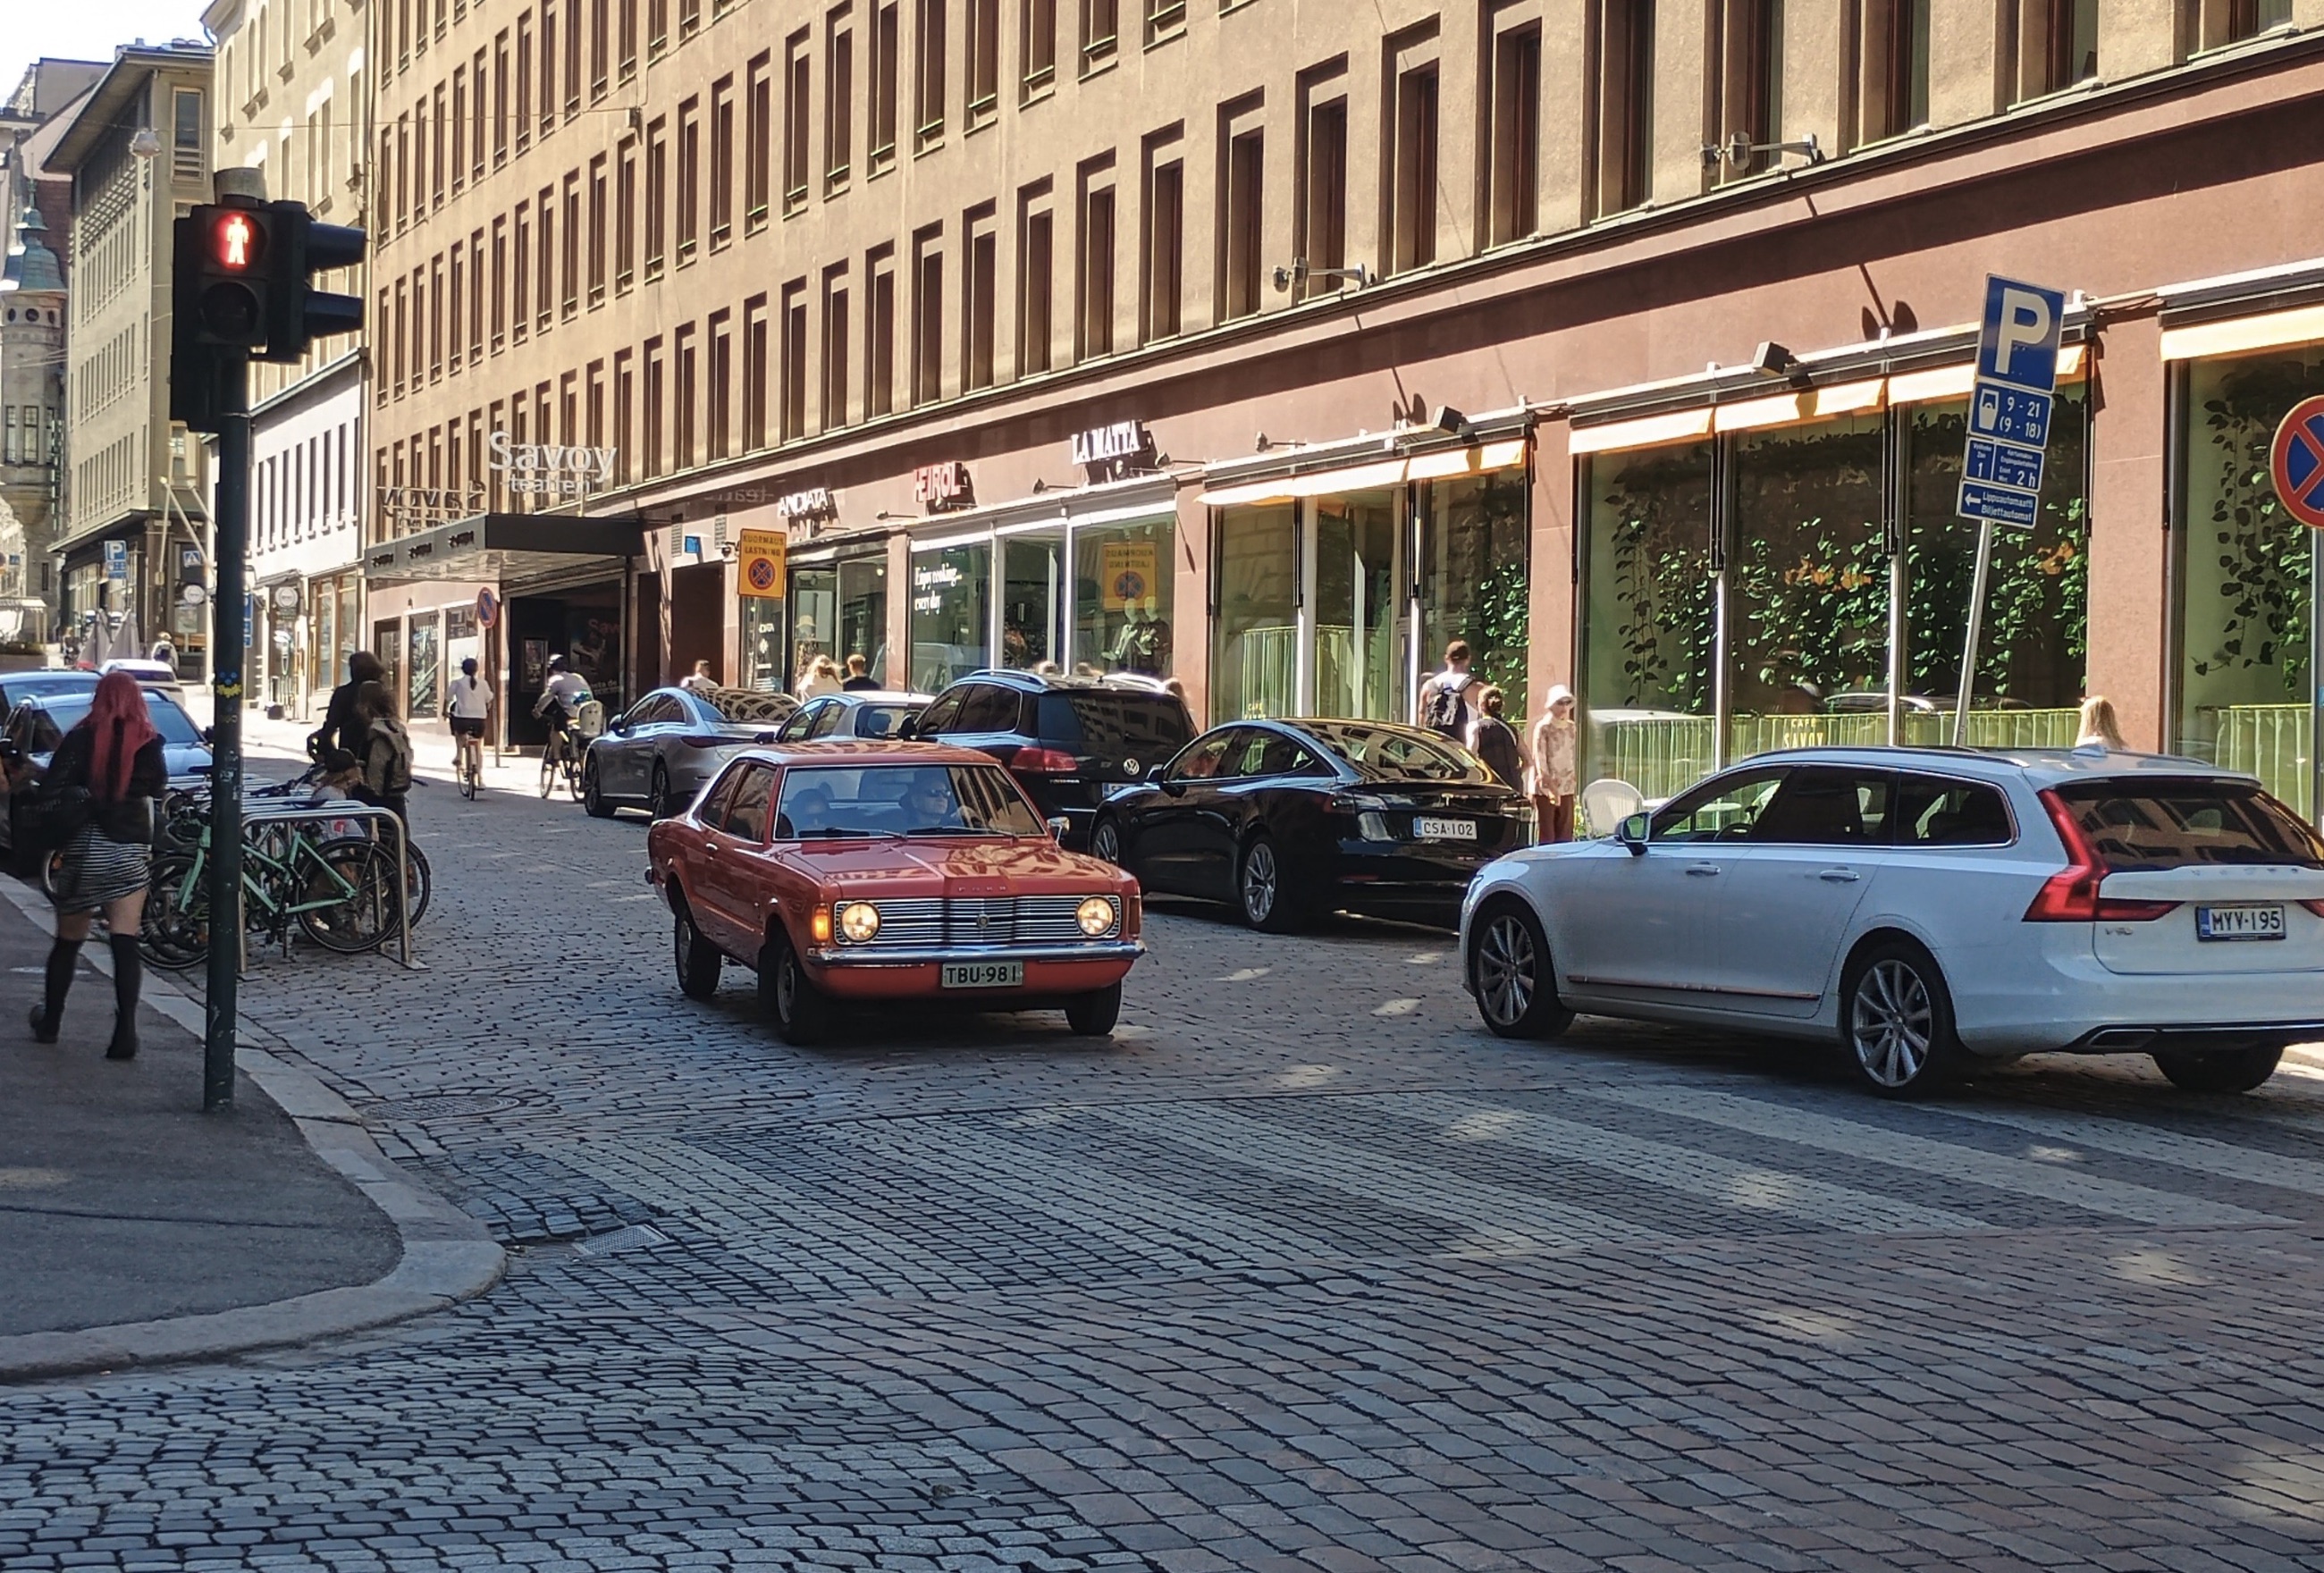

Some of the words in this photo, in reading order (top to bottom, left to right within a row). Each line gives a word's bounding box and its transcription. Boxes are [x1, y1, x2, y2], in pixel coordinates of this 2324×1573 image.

[1994, 287, 2050, 374] P
[2007, 397, 2015, 412] 9
[2027, 401, 2040, 417] 21
[1999, 416, 2011, 433] (9
[2025, 422, 2042, 439] 18)
[1071, 432, 1090, 465] LA
[1091, 419, 1141, 461] MATTA
[489, 431, 618, 483] Savoy
[1977, 462, 1983, 478] 1
[2017, 470, 2025, 485] 2
[2028, 472, 2036, 488] h
[1981, 504, 2033, 522] Biljettautomat
[743, 534, 784, 546] KUORMAUS
[109, 543, 123, 559] P
[745, 547, 780, 557] LASTNING
[1784, 732, 1823, 749] SAVOY
[1423, 822, 1473, 837] CSA-102
[946, 965, 1016, 984] TBU-981
